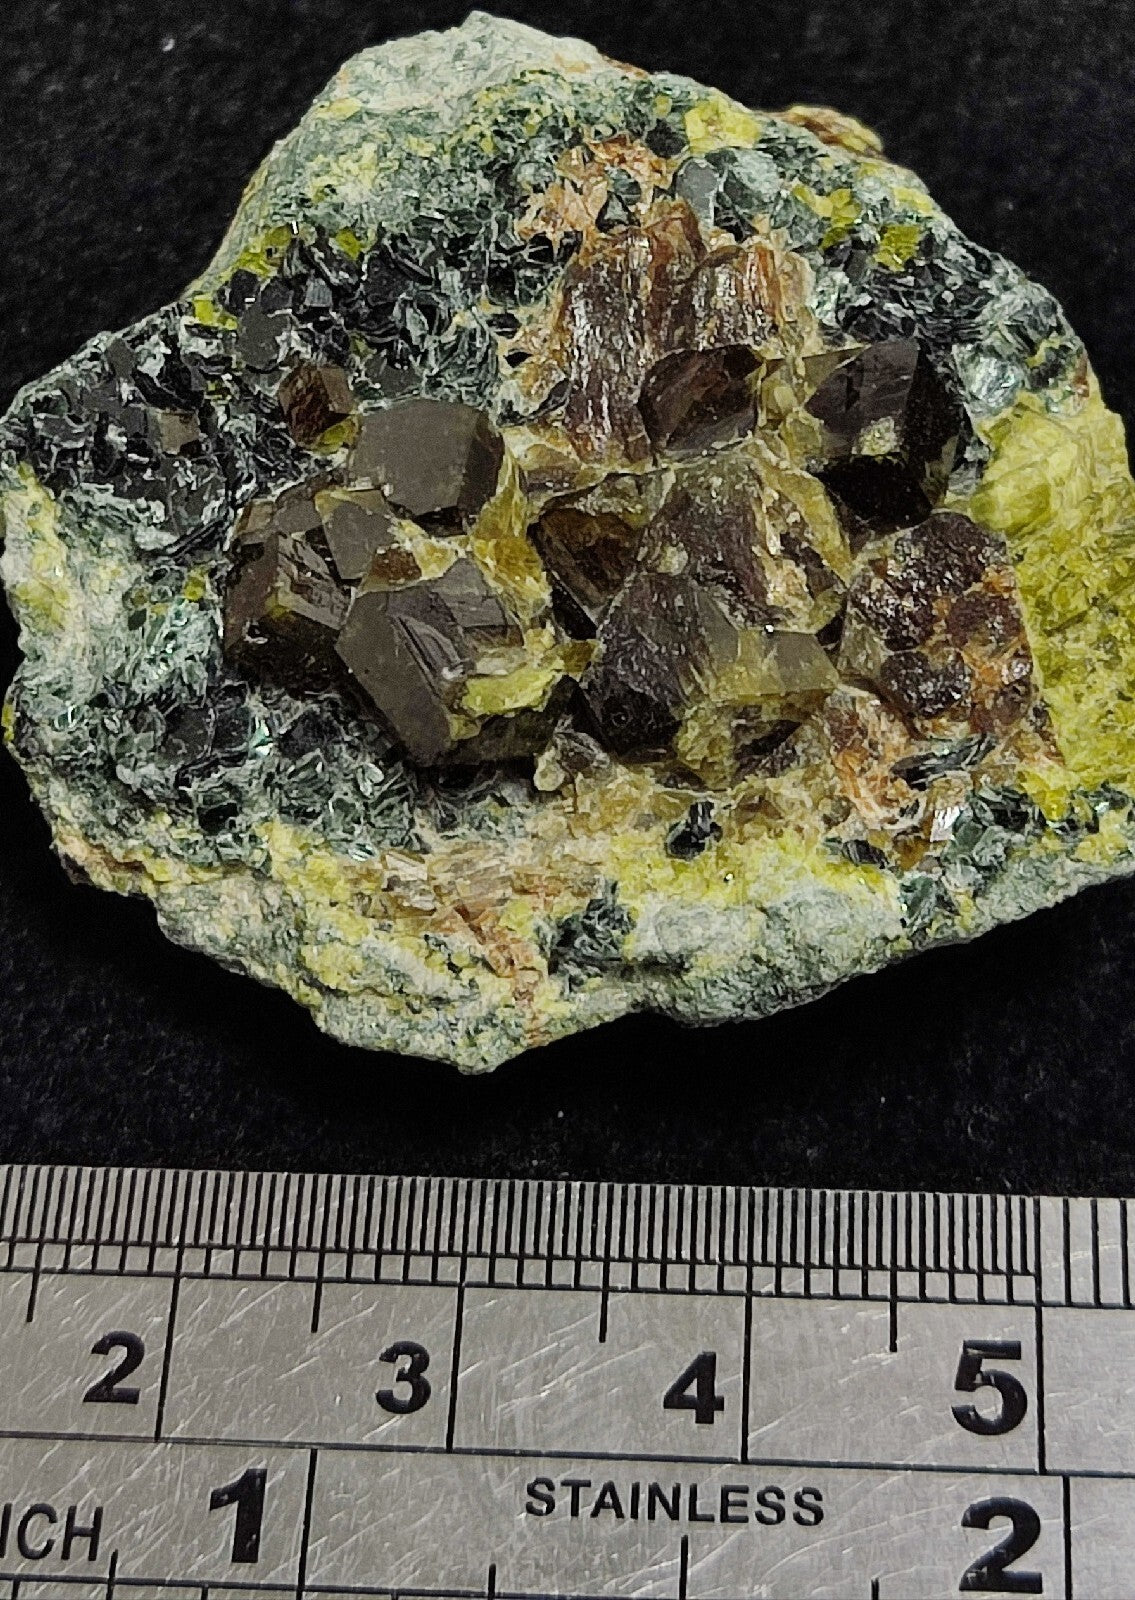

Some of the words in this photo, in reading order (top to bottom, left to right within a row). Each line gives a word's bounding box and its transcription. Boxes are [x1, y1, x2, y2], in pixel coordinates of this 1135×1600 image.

[82, 1330, 145, 1405] 2
[375, 1340, 432, 1415] 3
[663, 1351, 725, 1425] 4
[951, 1340, 1028, 1437] 5
[208, 1468, 268, 1564] 1
[524, 1477, 825, 1527] STAINLESS
[958, 1497, 1044, 1595] 2
